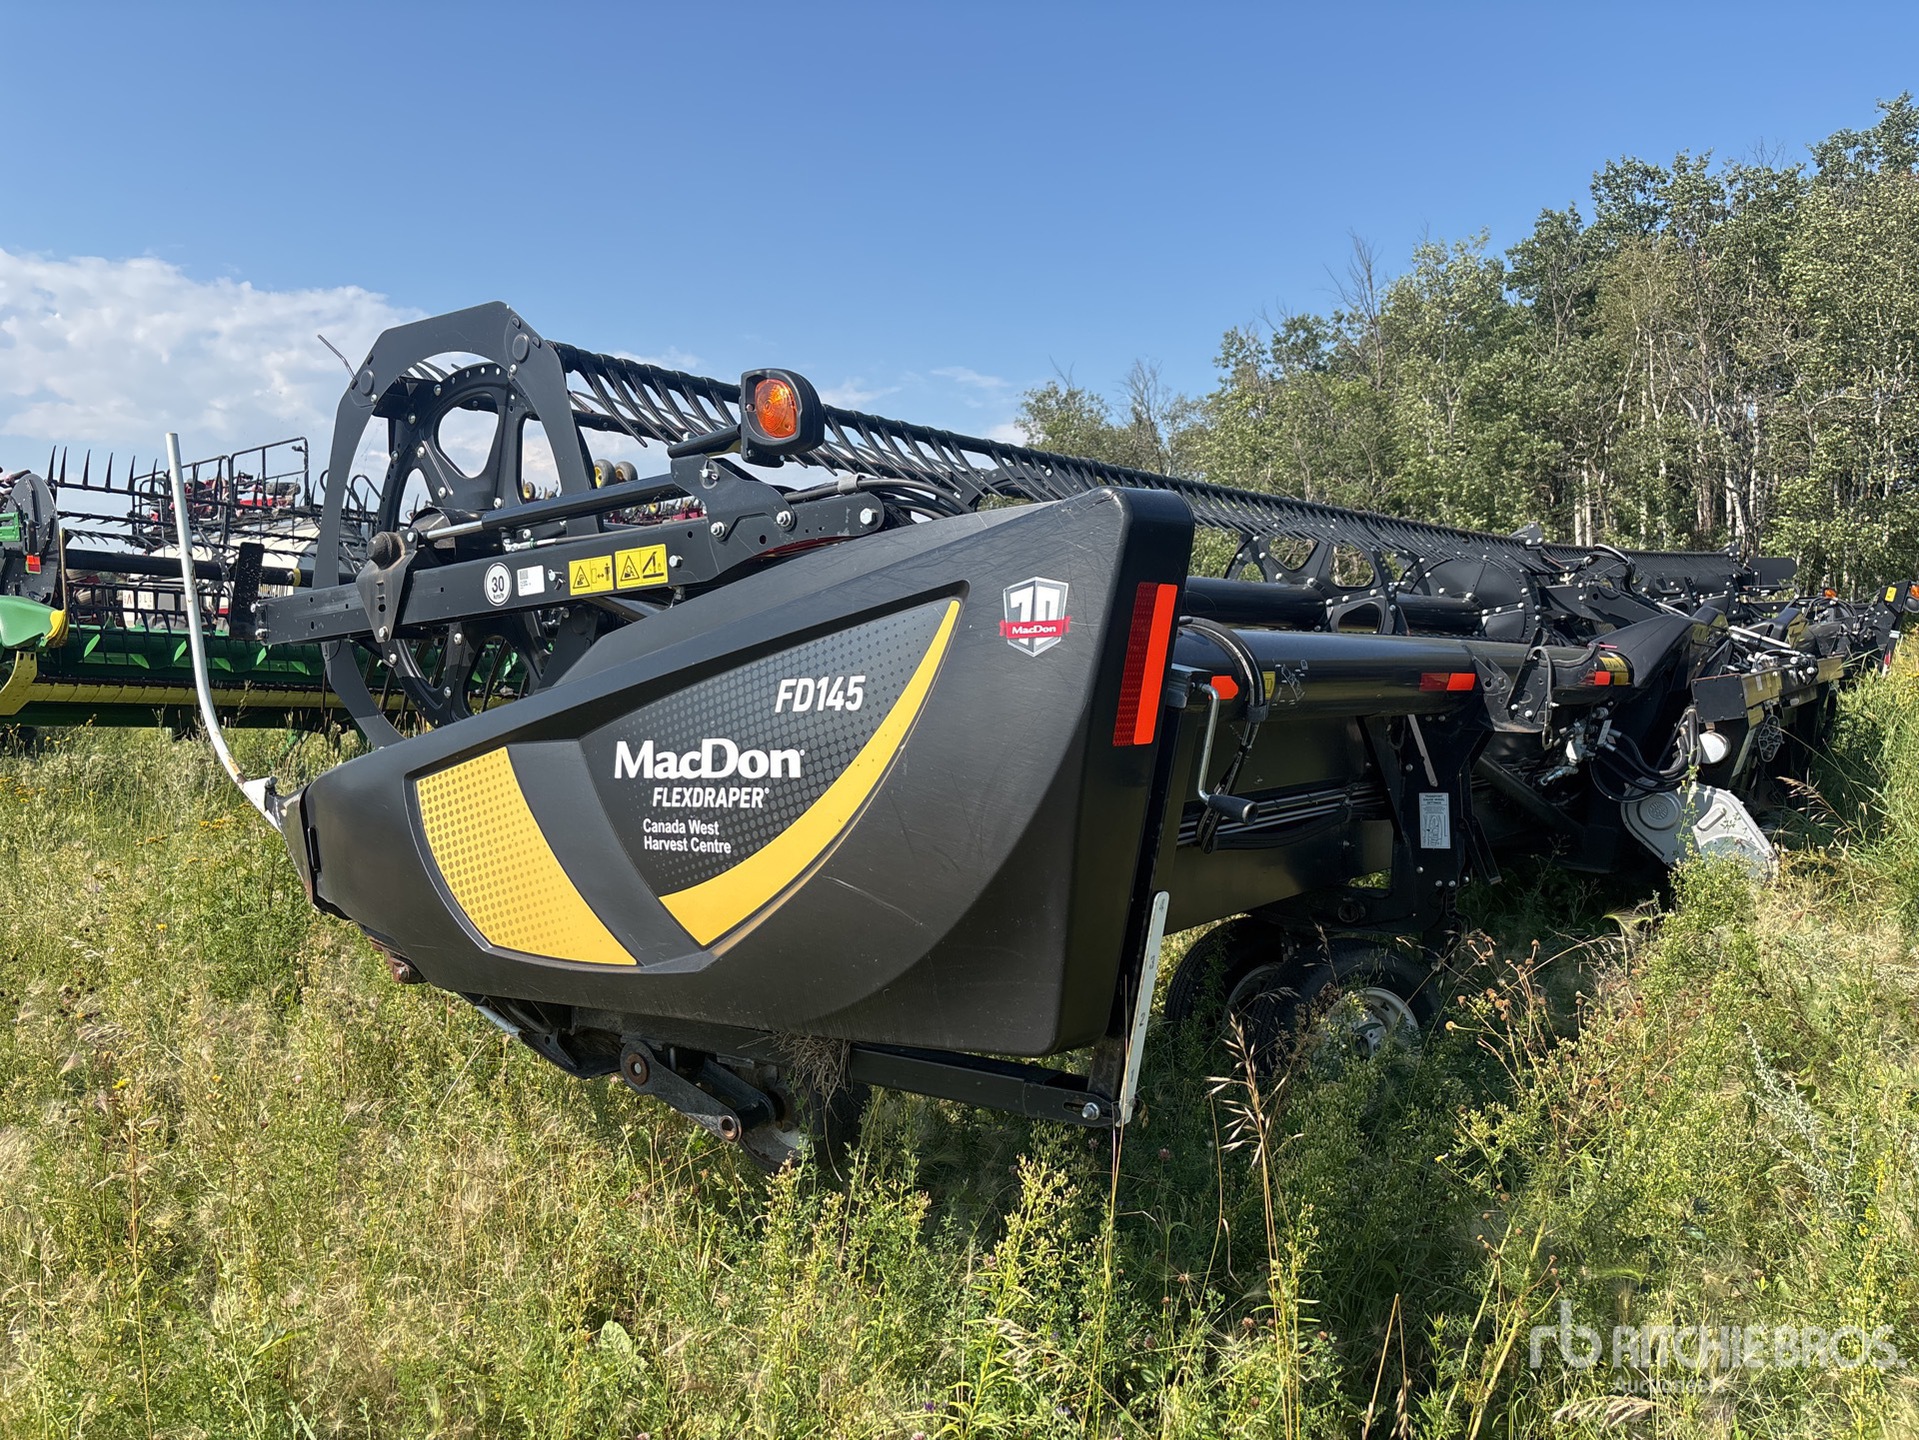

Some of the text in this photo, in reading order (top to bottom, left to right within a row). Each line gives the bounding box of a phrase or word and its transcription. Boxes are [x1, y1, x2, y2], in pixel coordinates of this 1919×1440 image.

[492, 576, 504, 593] 30
[1012, 625, 1056, 634] MacDon
[775, 675, 866, 713] FD145
[614, 738, 802, 779] MacDon
[652, 786, 765, 808] FLEXDRAPER
[642, 818, 720, 836] Canada West
[643, 836, 732, 854] Harvest Centre
